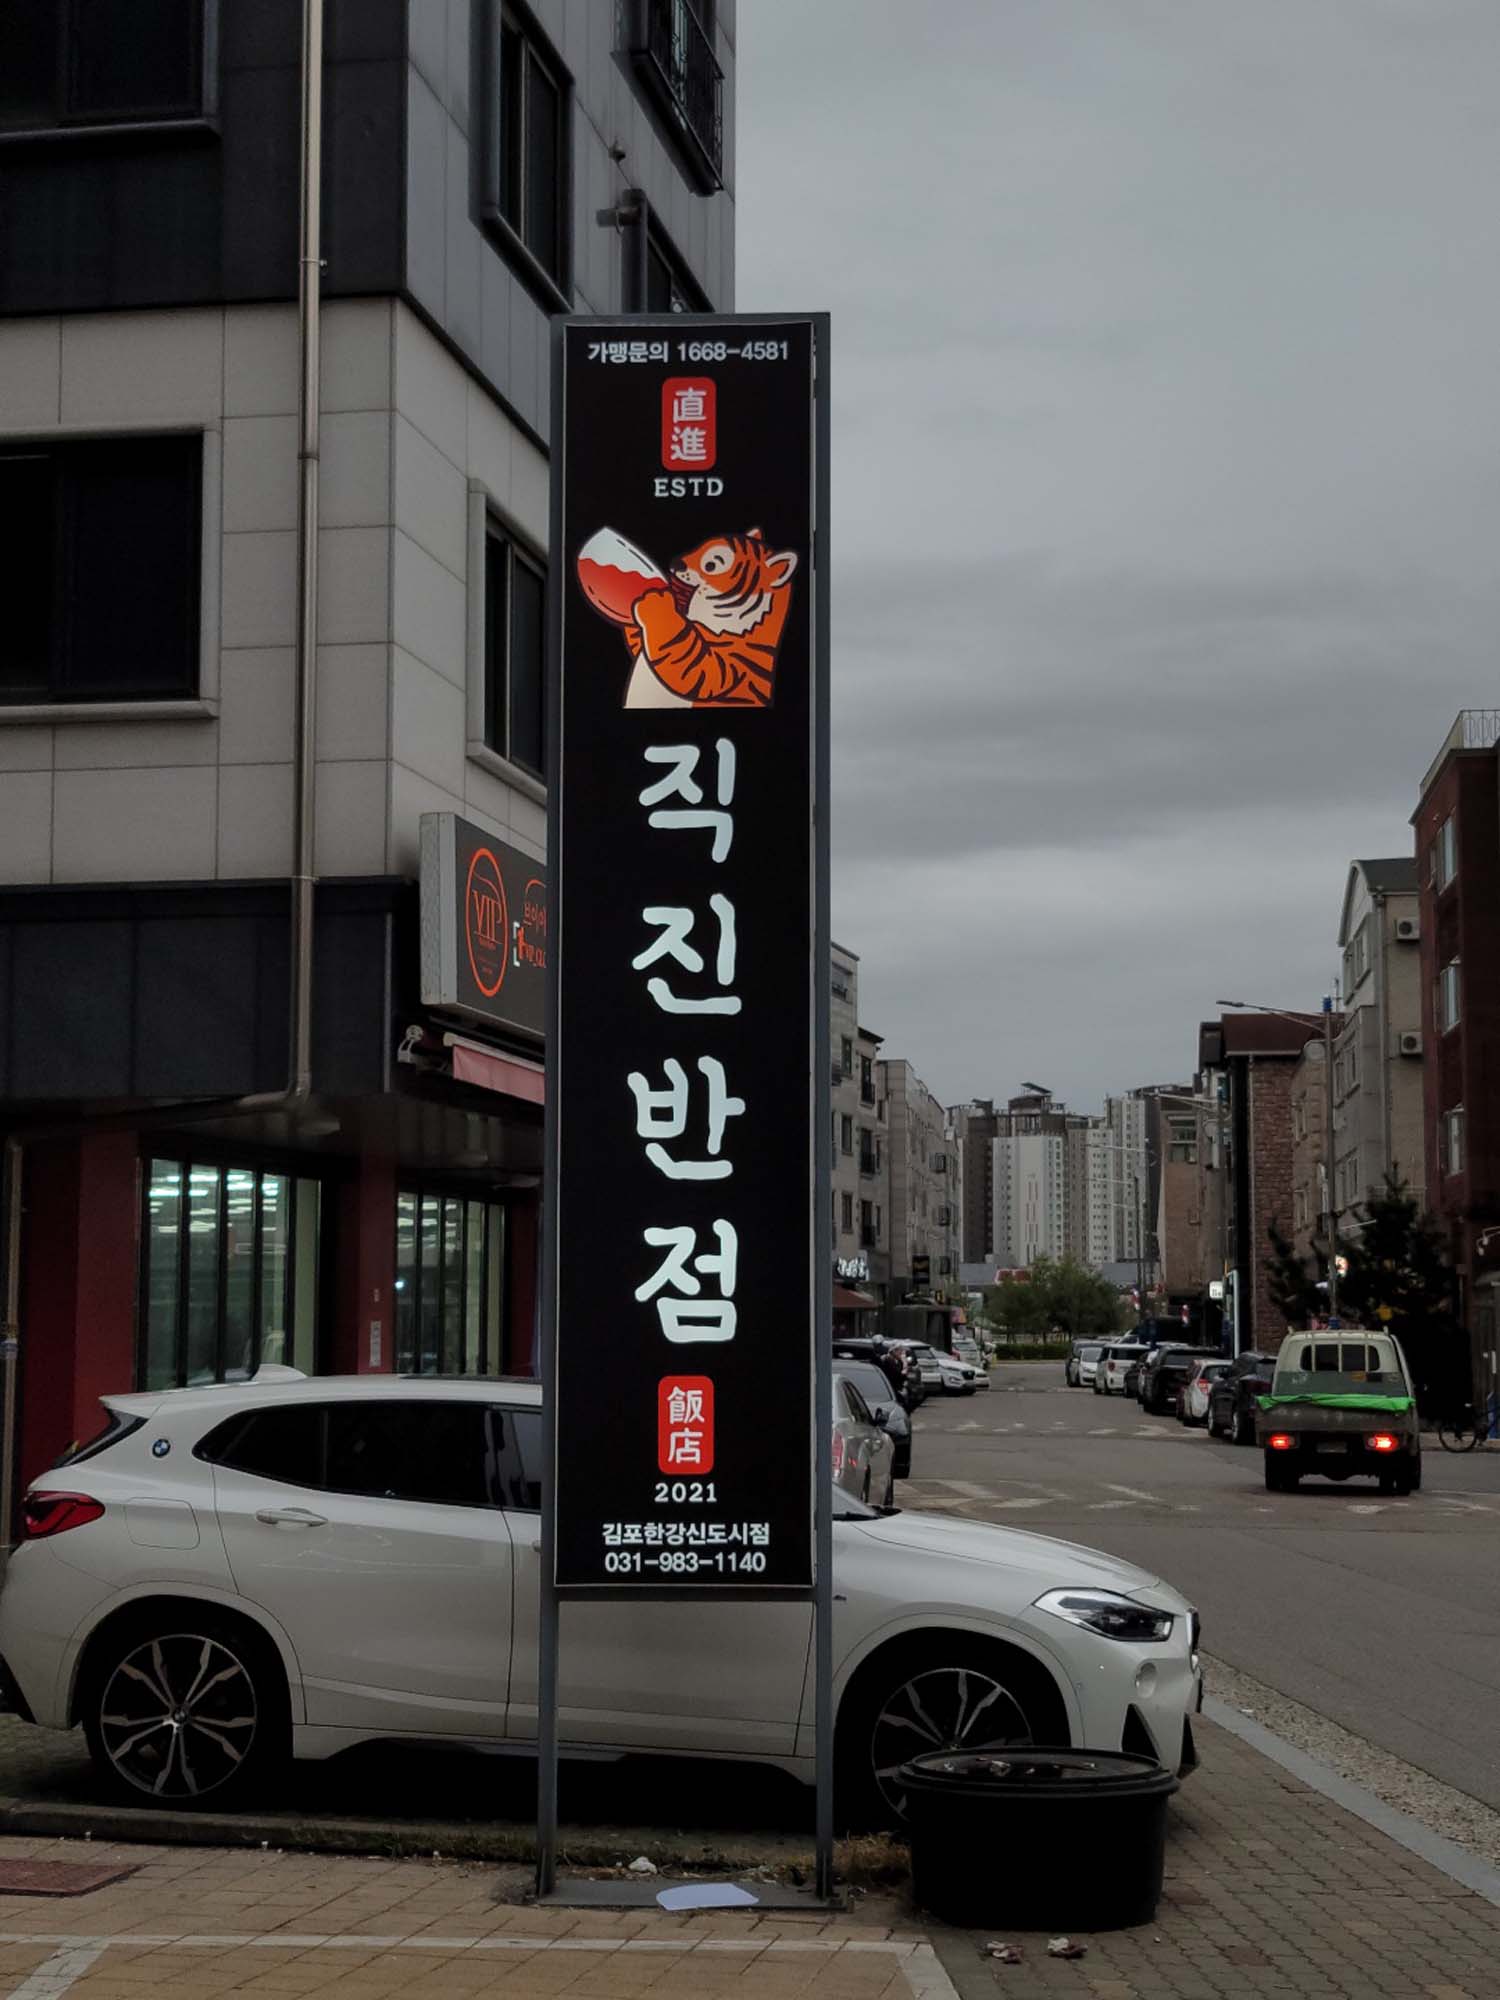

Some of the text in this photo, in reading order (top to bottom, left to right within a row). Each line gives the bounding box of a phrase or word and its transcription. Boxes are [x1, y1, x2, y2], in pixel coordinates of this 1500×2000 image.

[587, 341, 789, 364] 가맹문의 1668-4581
[670, 386, 708, 462] 直進
[653, 477, 724, 498] ESTD
[627, 737, 746, 1344] 직진반점
[666, 1385, 705, 1465] 飯店
[653, 1482, 718, 1503] 2021
[602, 1521, 771, 1546] 김포한강신도시점
[603, 1551, 767, 1573] 031-983-1140
